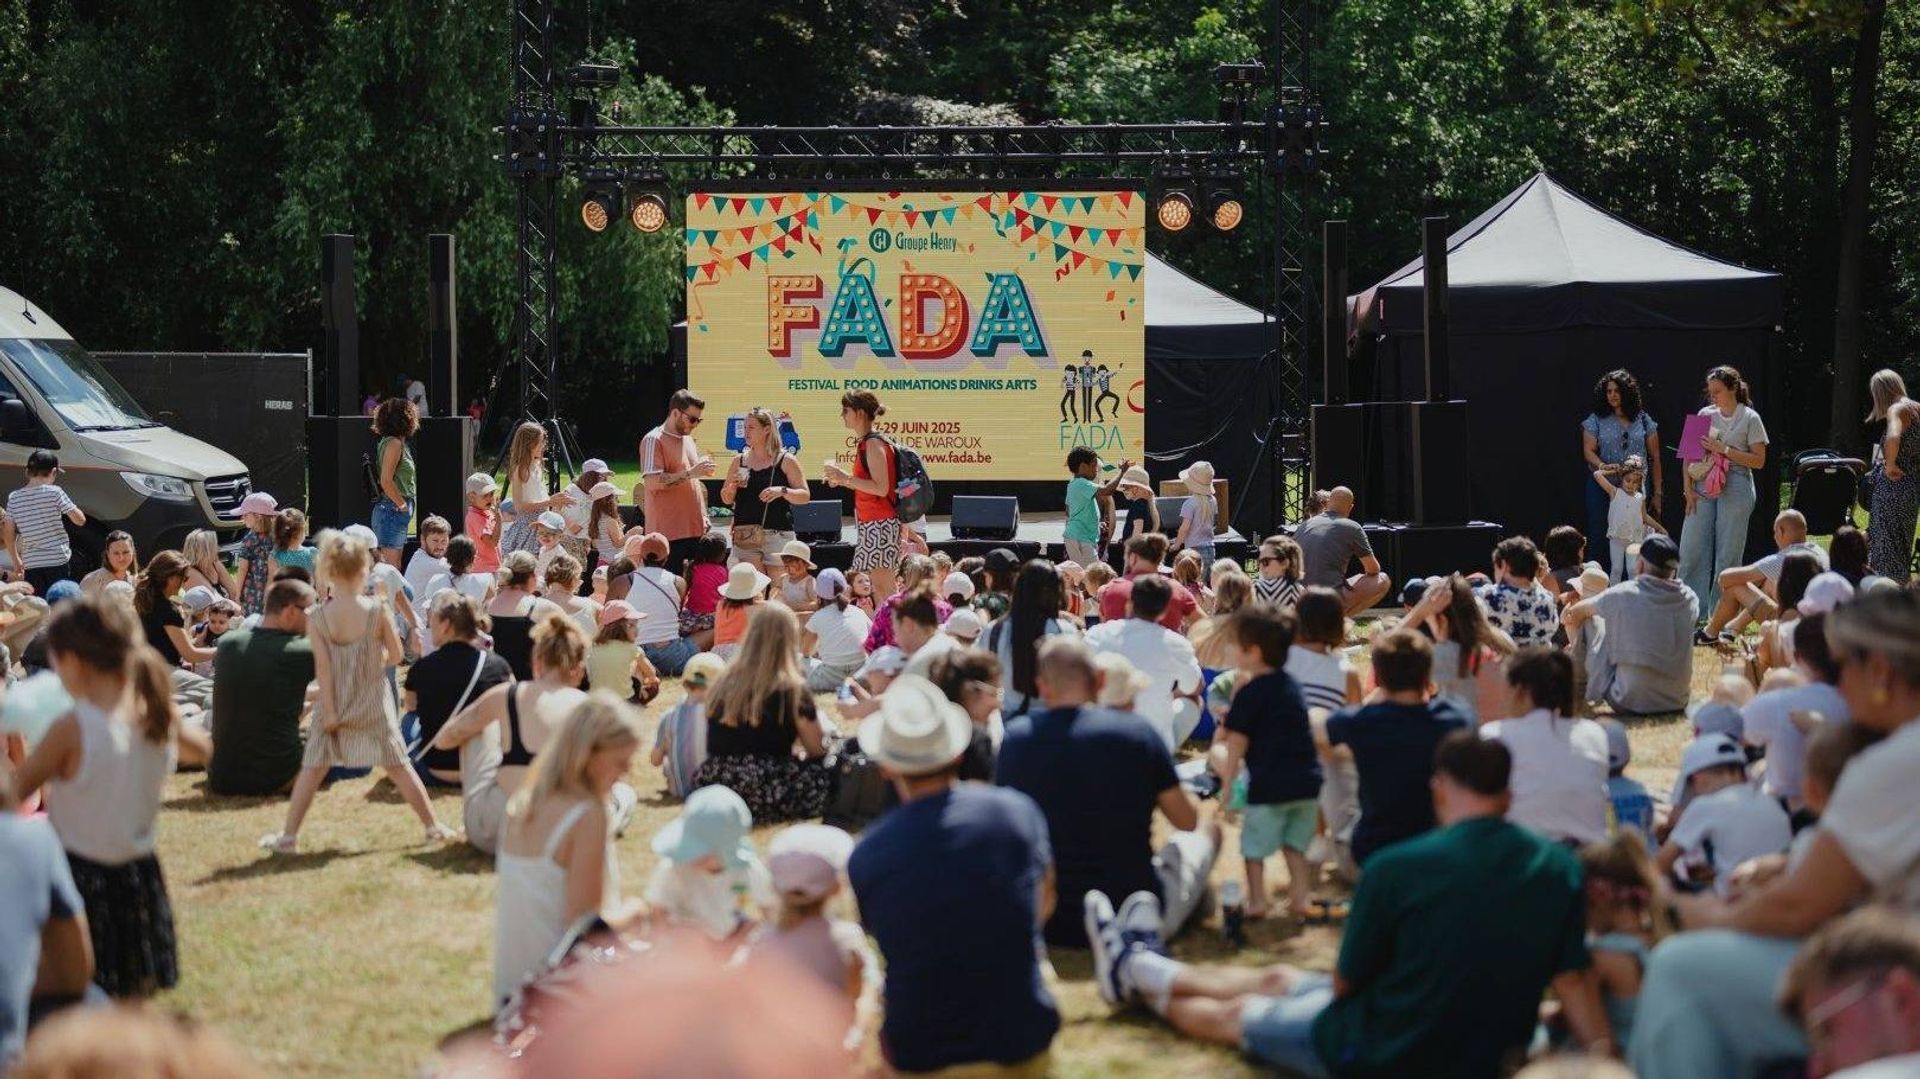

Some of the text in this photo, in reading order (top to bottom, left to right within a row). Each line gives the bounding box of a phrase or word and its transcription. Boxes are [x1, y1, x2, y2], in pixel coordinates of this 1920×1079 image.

[895, 232, 957, 252] Groupe Henry
[767, 274, 1049, 359] FADA
[788, 379, 1037, 390] FESTIVAL FOOD ANIMATIONS DRINKS ARTS
[901, 422, 928, 433] JUIN
[931, 422, 960, 433] 2025
[906, 437, 922, 447] DE
[925, 437, 981, 448] WAROUX
[1060, 425, 1124, 449] FADA
[922, 451, 992, 463] ww.fada.be
